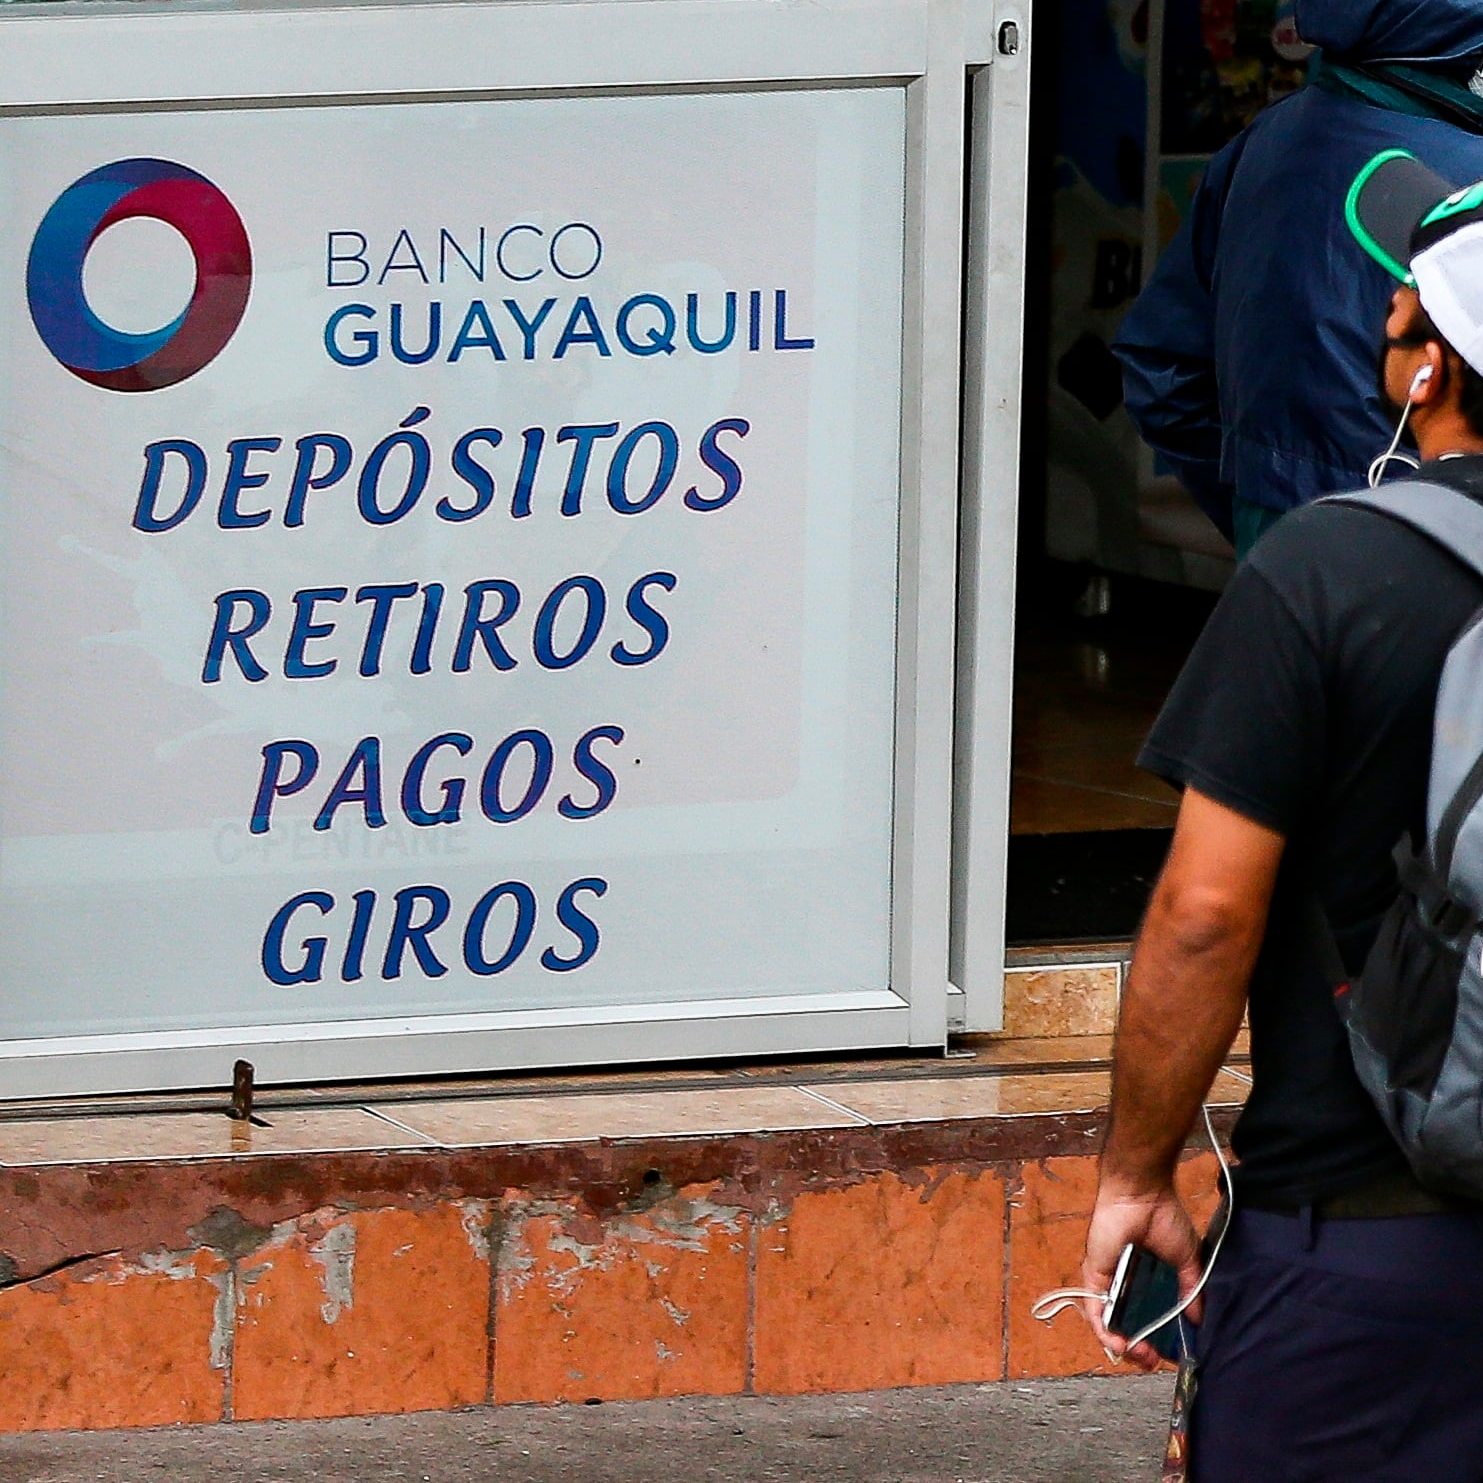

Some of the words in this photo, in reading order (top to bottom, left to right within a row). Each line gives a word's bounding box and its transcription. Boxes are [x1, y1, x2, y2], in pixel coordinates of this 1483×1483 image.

[324, 223, 603, 288] BANCO
[323, 289, 815, 367] GUAYAQUIL
[131, 405, 752, 534] DEPÓSITOS
[200, 571, 678, 684] RETIROS
[249, 725, 625, 836] PAGOS
[261, 877, 608, 987] GIROS
